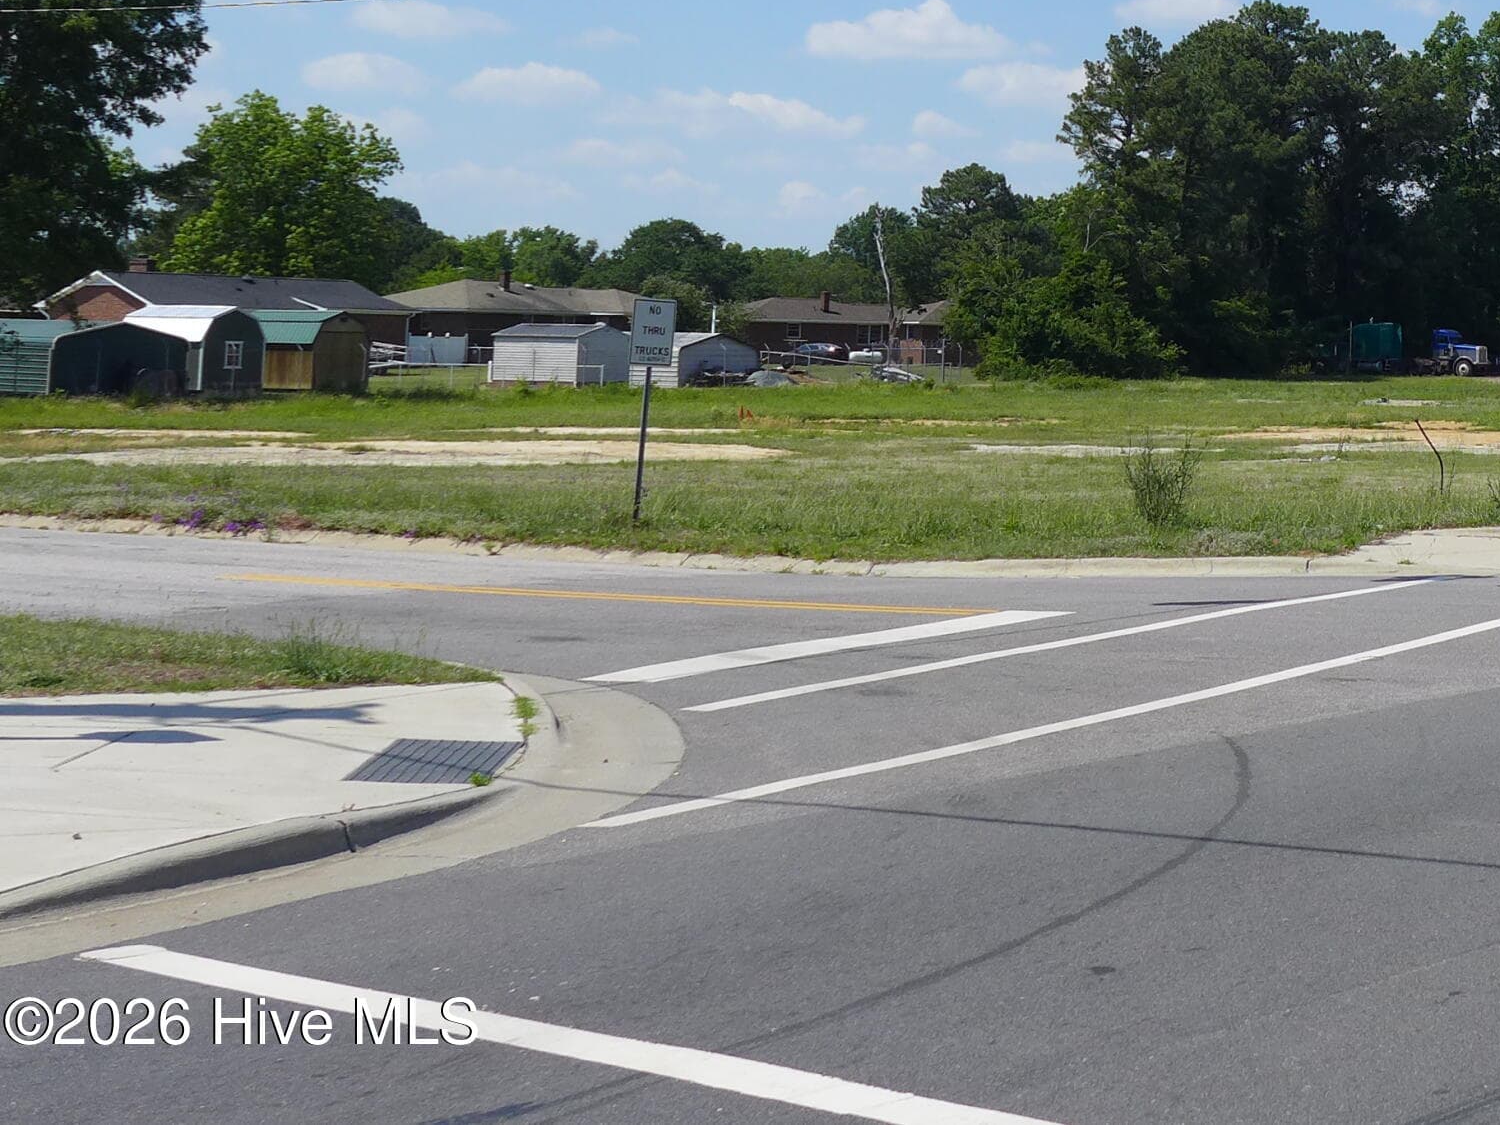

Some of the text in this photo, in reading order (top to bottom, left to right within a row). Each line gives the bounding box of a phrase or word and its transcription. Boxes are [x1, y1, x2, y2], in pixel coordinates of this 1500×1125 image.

[649, 305, 662, 315] NO
[642, 325, 666, 335] THRU
[635, 345, 670, 356] TRUCKS
